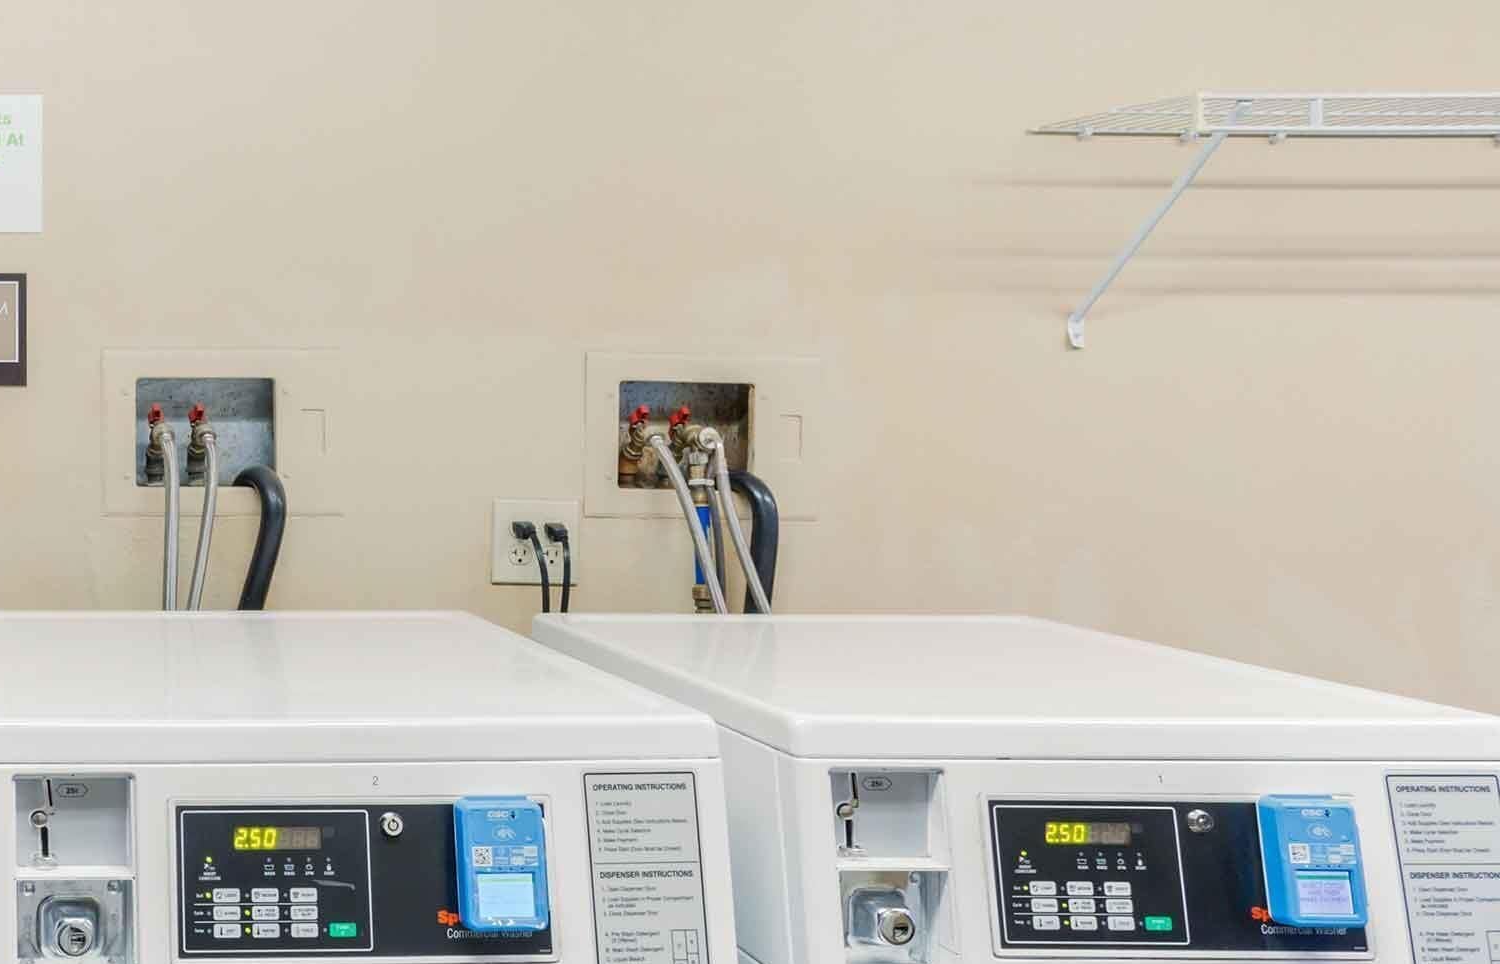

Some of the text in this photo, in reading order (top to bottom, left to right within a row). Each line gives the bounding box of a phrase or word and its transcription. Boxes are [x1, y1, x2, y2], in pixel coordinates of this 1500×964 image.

[6, 132, 25, 147] At
[372, 775, 380, 786] 2
[593, 782, 687, 791] OPERATING INSTRUCTIONS
[234, 827, 278, 849] 2.50
[1045, 824, 1086, 844] 2.50
[599, 870, 693, 879] DISPENSER INSTRUCTIONS
